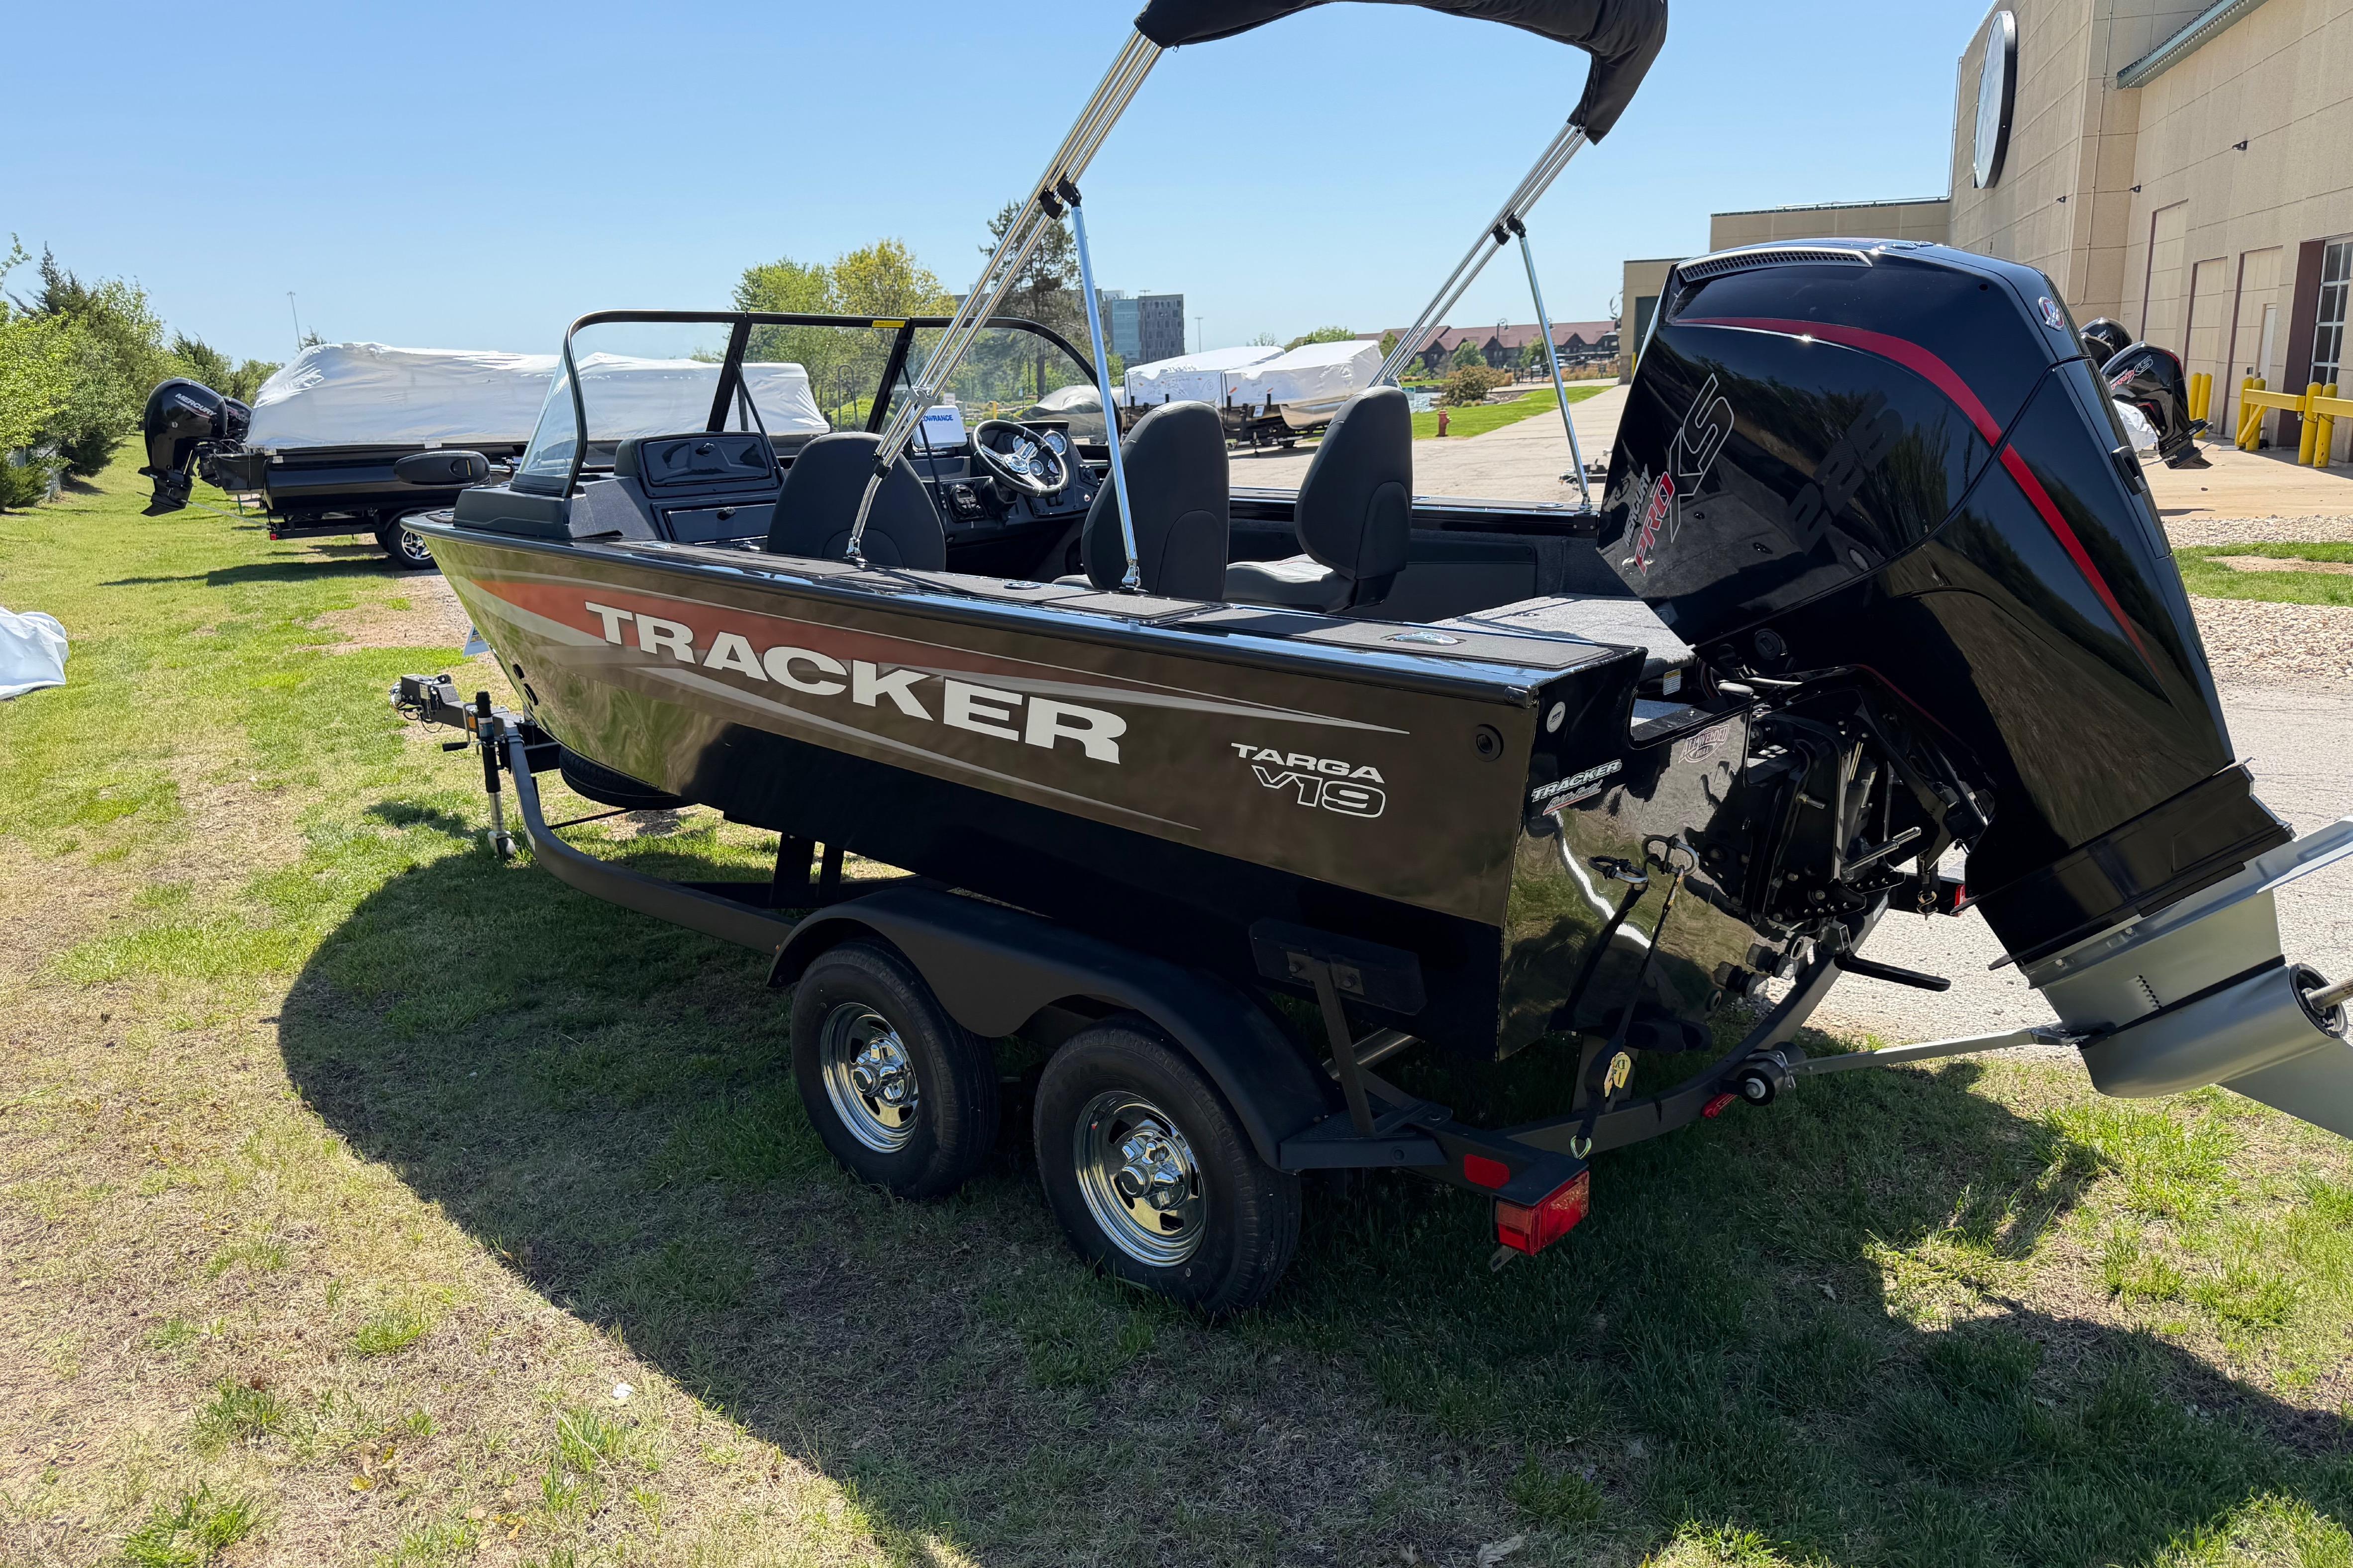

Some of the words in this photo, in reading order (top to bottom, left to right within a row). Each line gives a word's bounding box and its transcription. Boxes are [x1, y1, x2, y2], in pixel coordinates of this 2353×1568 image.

[175, 393, 217, 416] MERCURY
[1623, 464, 1651, 547] MERCURY
[1634, 471, 1675, 577] PRO
[1669, 373, 1734, 543] XS
[585, 601, 1127, 765] TRACKER
[1231, 743, 1385, 784] TARGA
[1251, 765, 1386, 818] V19
